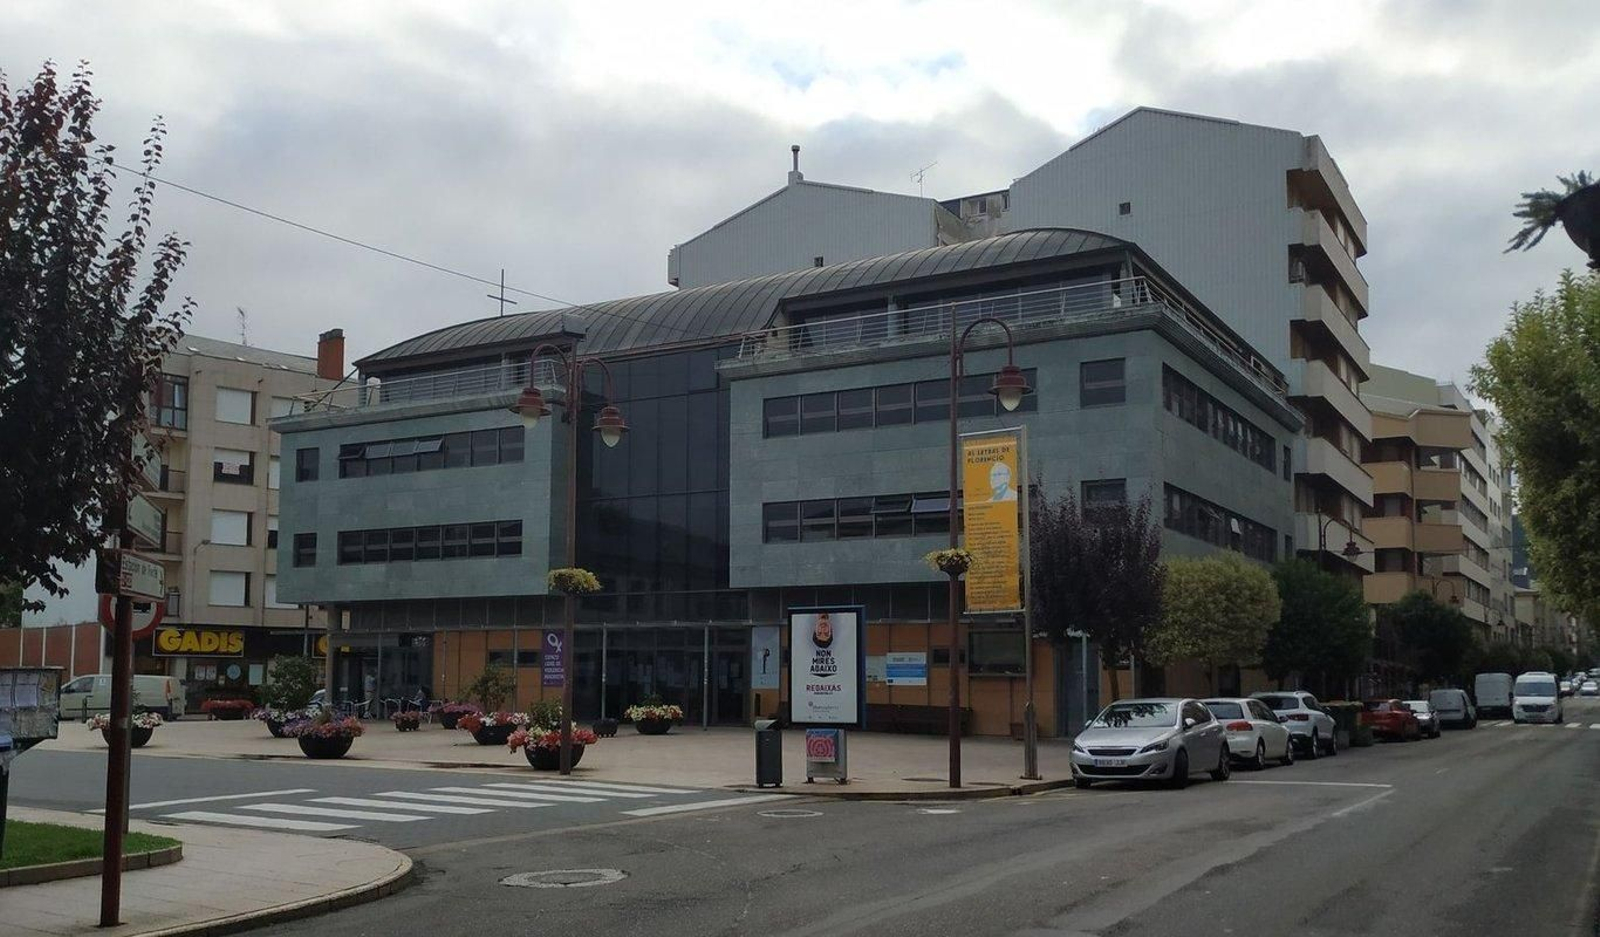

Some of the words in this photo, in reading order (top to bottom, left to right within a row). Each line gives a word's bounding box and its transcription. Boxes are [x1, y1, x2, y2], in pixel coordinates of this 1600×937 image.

[157, 627, 244, 654] GADIS
[815, 649, 832, 657] NON
[812, 657, 836, 665] MIRES
